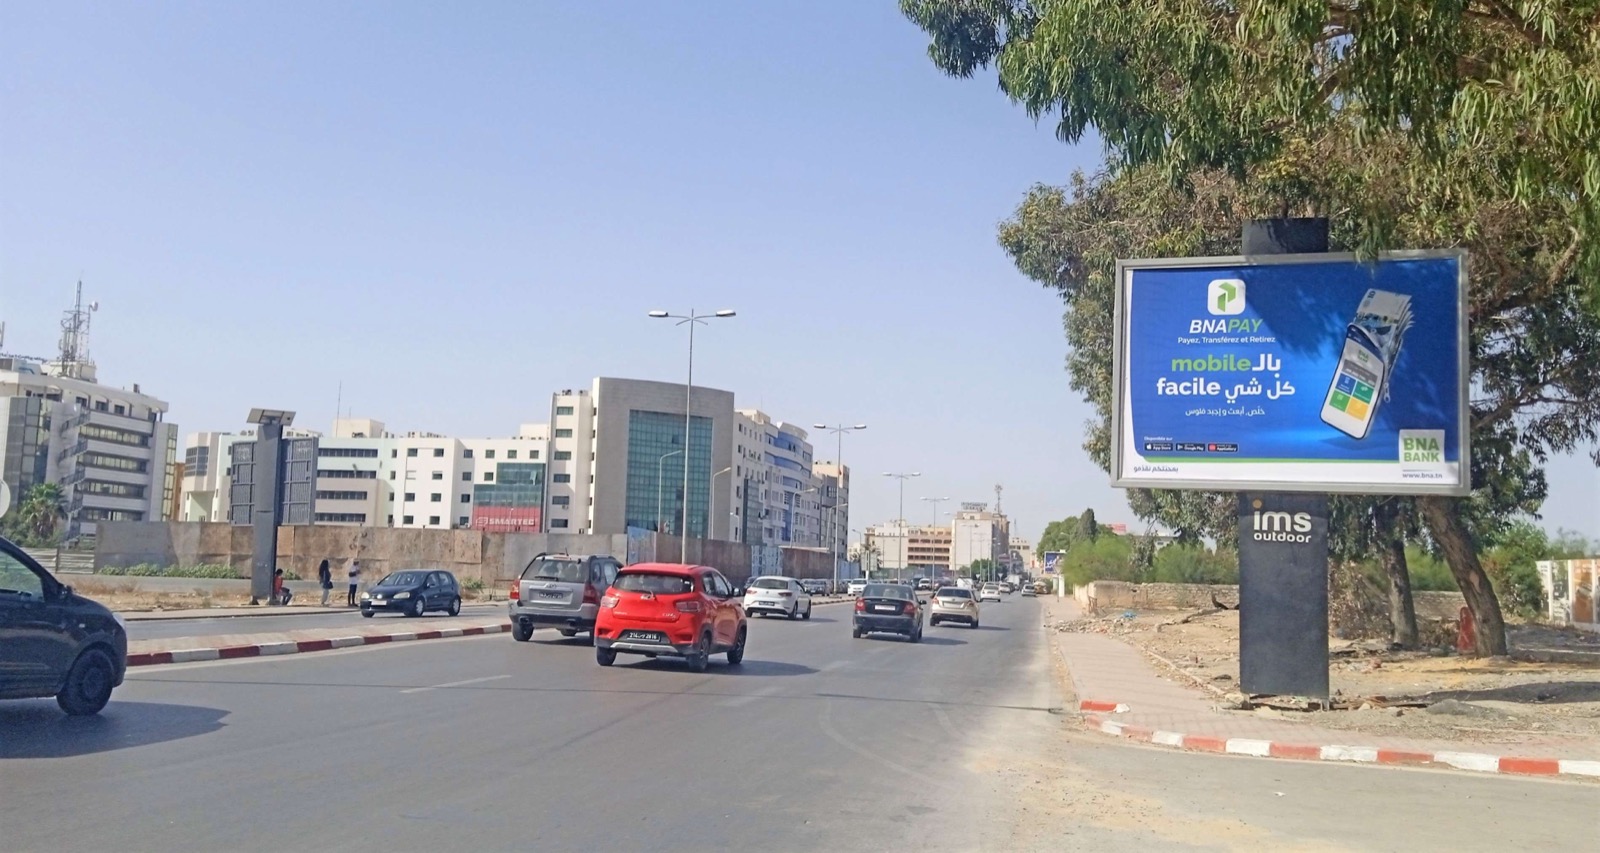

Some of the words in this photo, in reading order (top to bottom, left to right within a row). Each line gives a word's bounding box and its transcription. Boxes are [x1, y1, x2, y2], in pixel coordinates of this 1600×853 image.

[1189, 318, 1263, 334] BNAPAY
[1178, 336, 1201, 345] Payez,
[1202, 335, 1239, 344] Transférez
[1249, 336, 1276, 344] Retirez
[1171, 354, 1251, 372] mobile
[1156, 377, 1221, 396] facile
[1225, 377, 1262, 404] شي
[1267, 379, 1296, 400] كل
[1403, 437, 1440, 451] BNA
[1403, 452, 1440, 462] BANK
[1252, 498, 1312, 533] ims
[1253, 531, 1312, 543] outdoor
